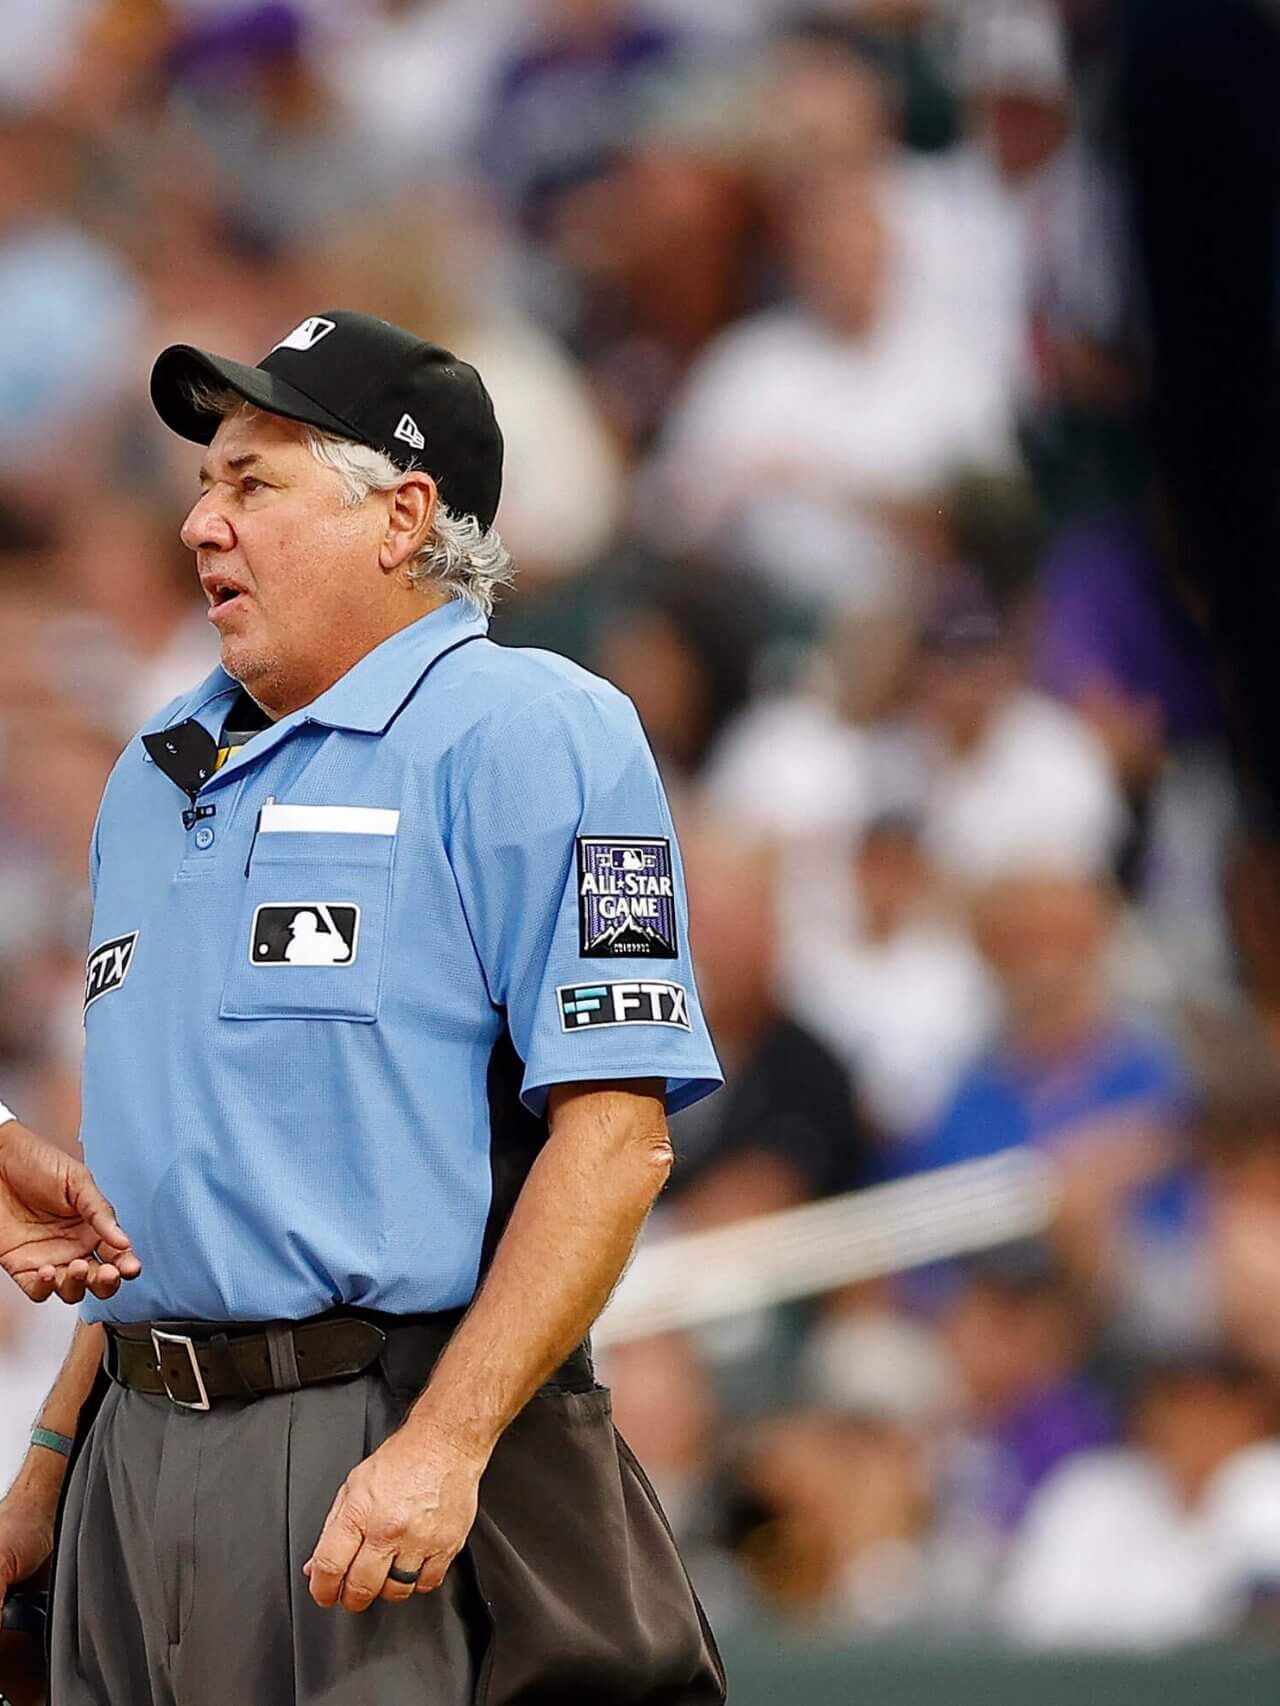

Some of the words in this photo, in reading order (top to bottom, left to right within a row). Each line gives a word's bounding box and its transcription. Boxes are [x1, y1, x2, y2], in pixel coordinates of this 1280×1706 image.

[599, 896, 660, 919] GAME
[86, 942, 132, 999] FTX
[611, 983, 689, 1025] FTX
